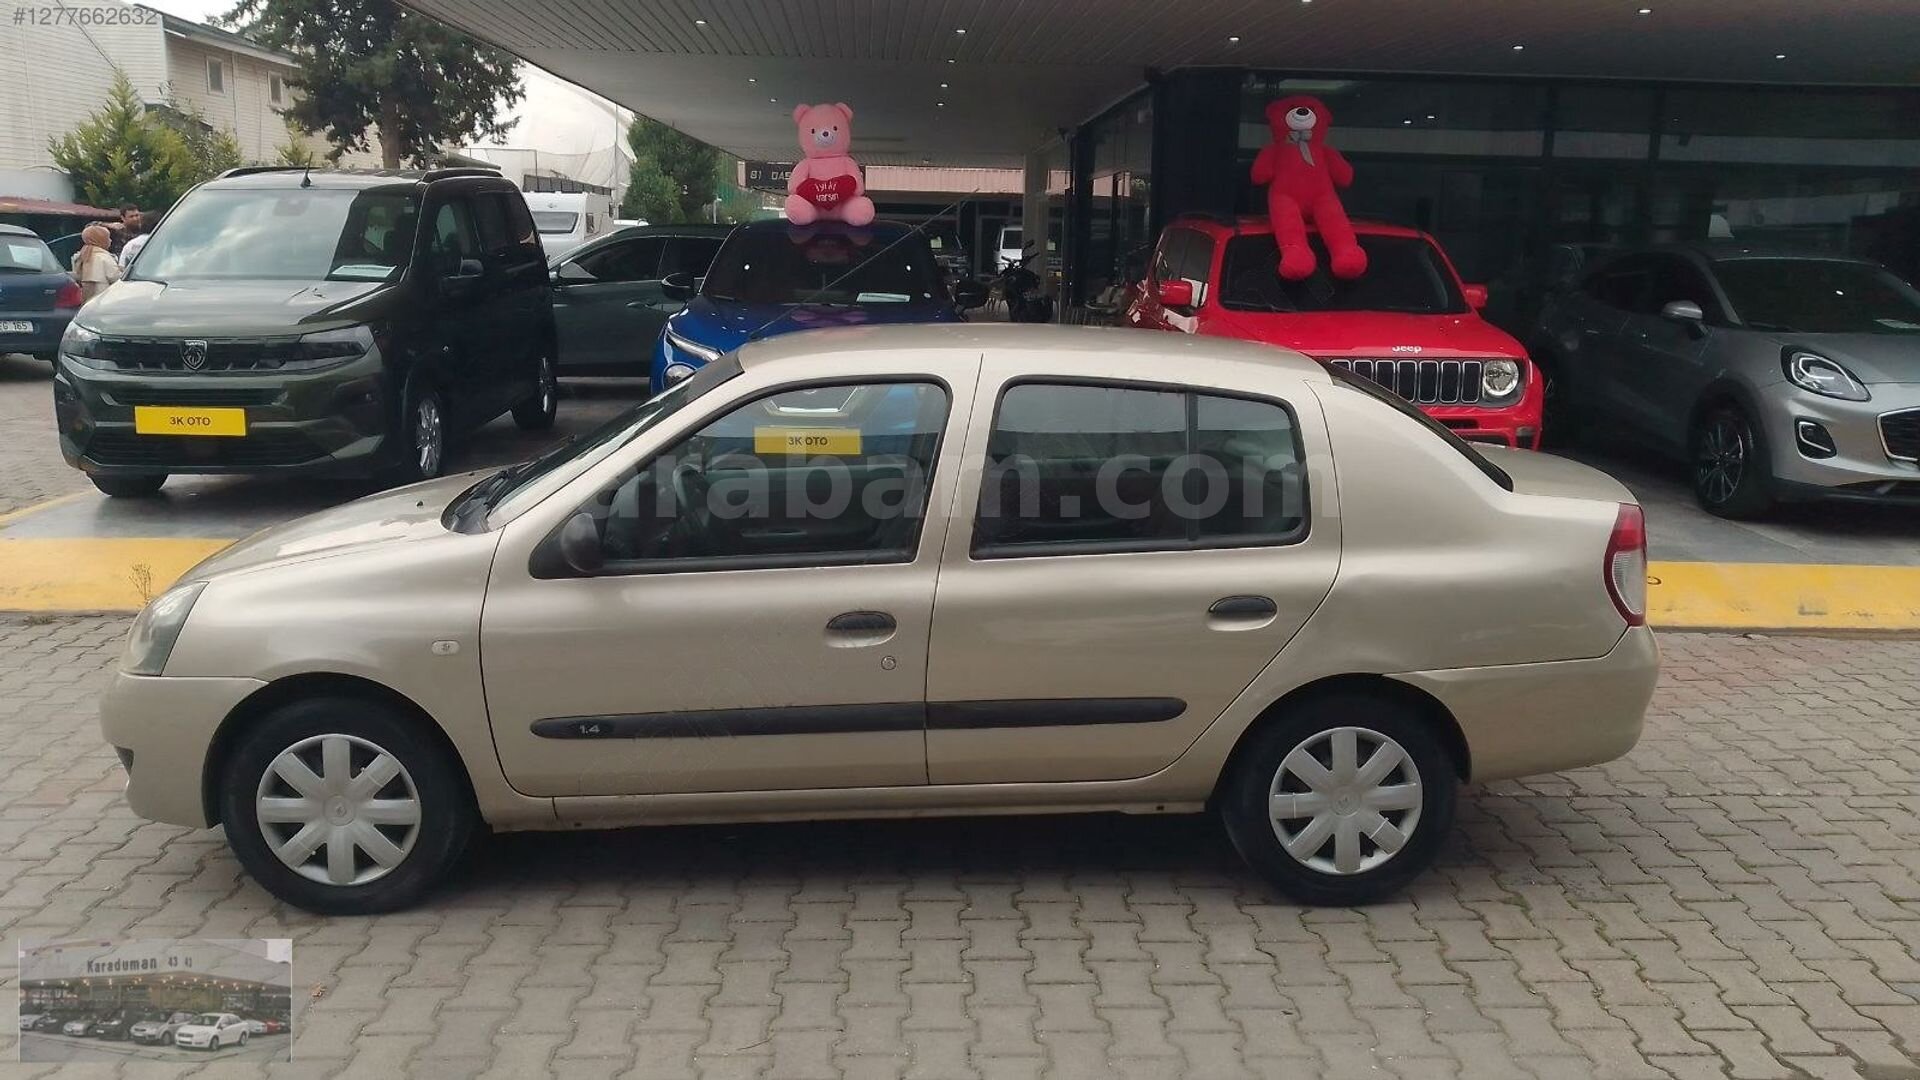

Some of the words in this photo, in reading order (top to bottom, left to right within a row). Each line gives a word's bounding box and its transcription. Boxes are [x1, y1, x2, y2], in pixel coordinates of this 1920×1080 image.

[1391, 345, 1423, 354] Jeep
[169, 416, 185, 426] 3K
[187, 416, 212, 426] OTO
[788, 436, 803, 446] 3K
[805, 436, 829, 446] OTO
[579, 724, 601, 735] 1.4
